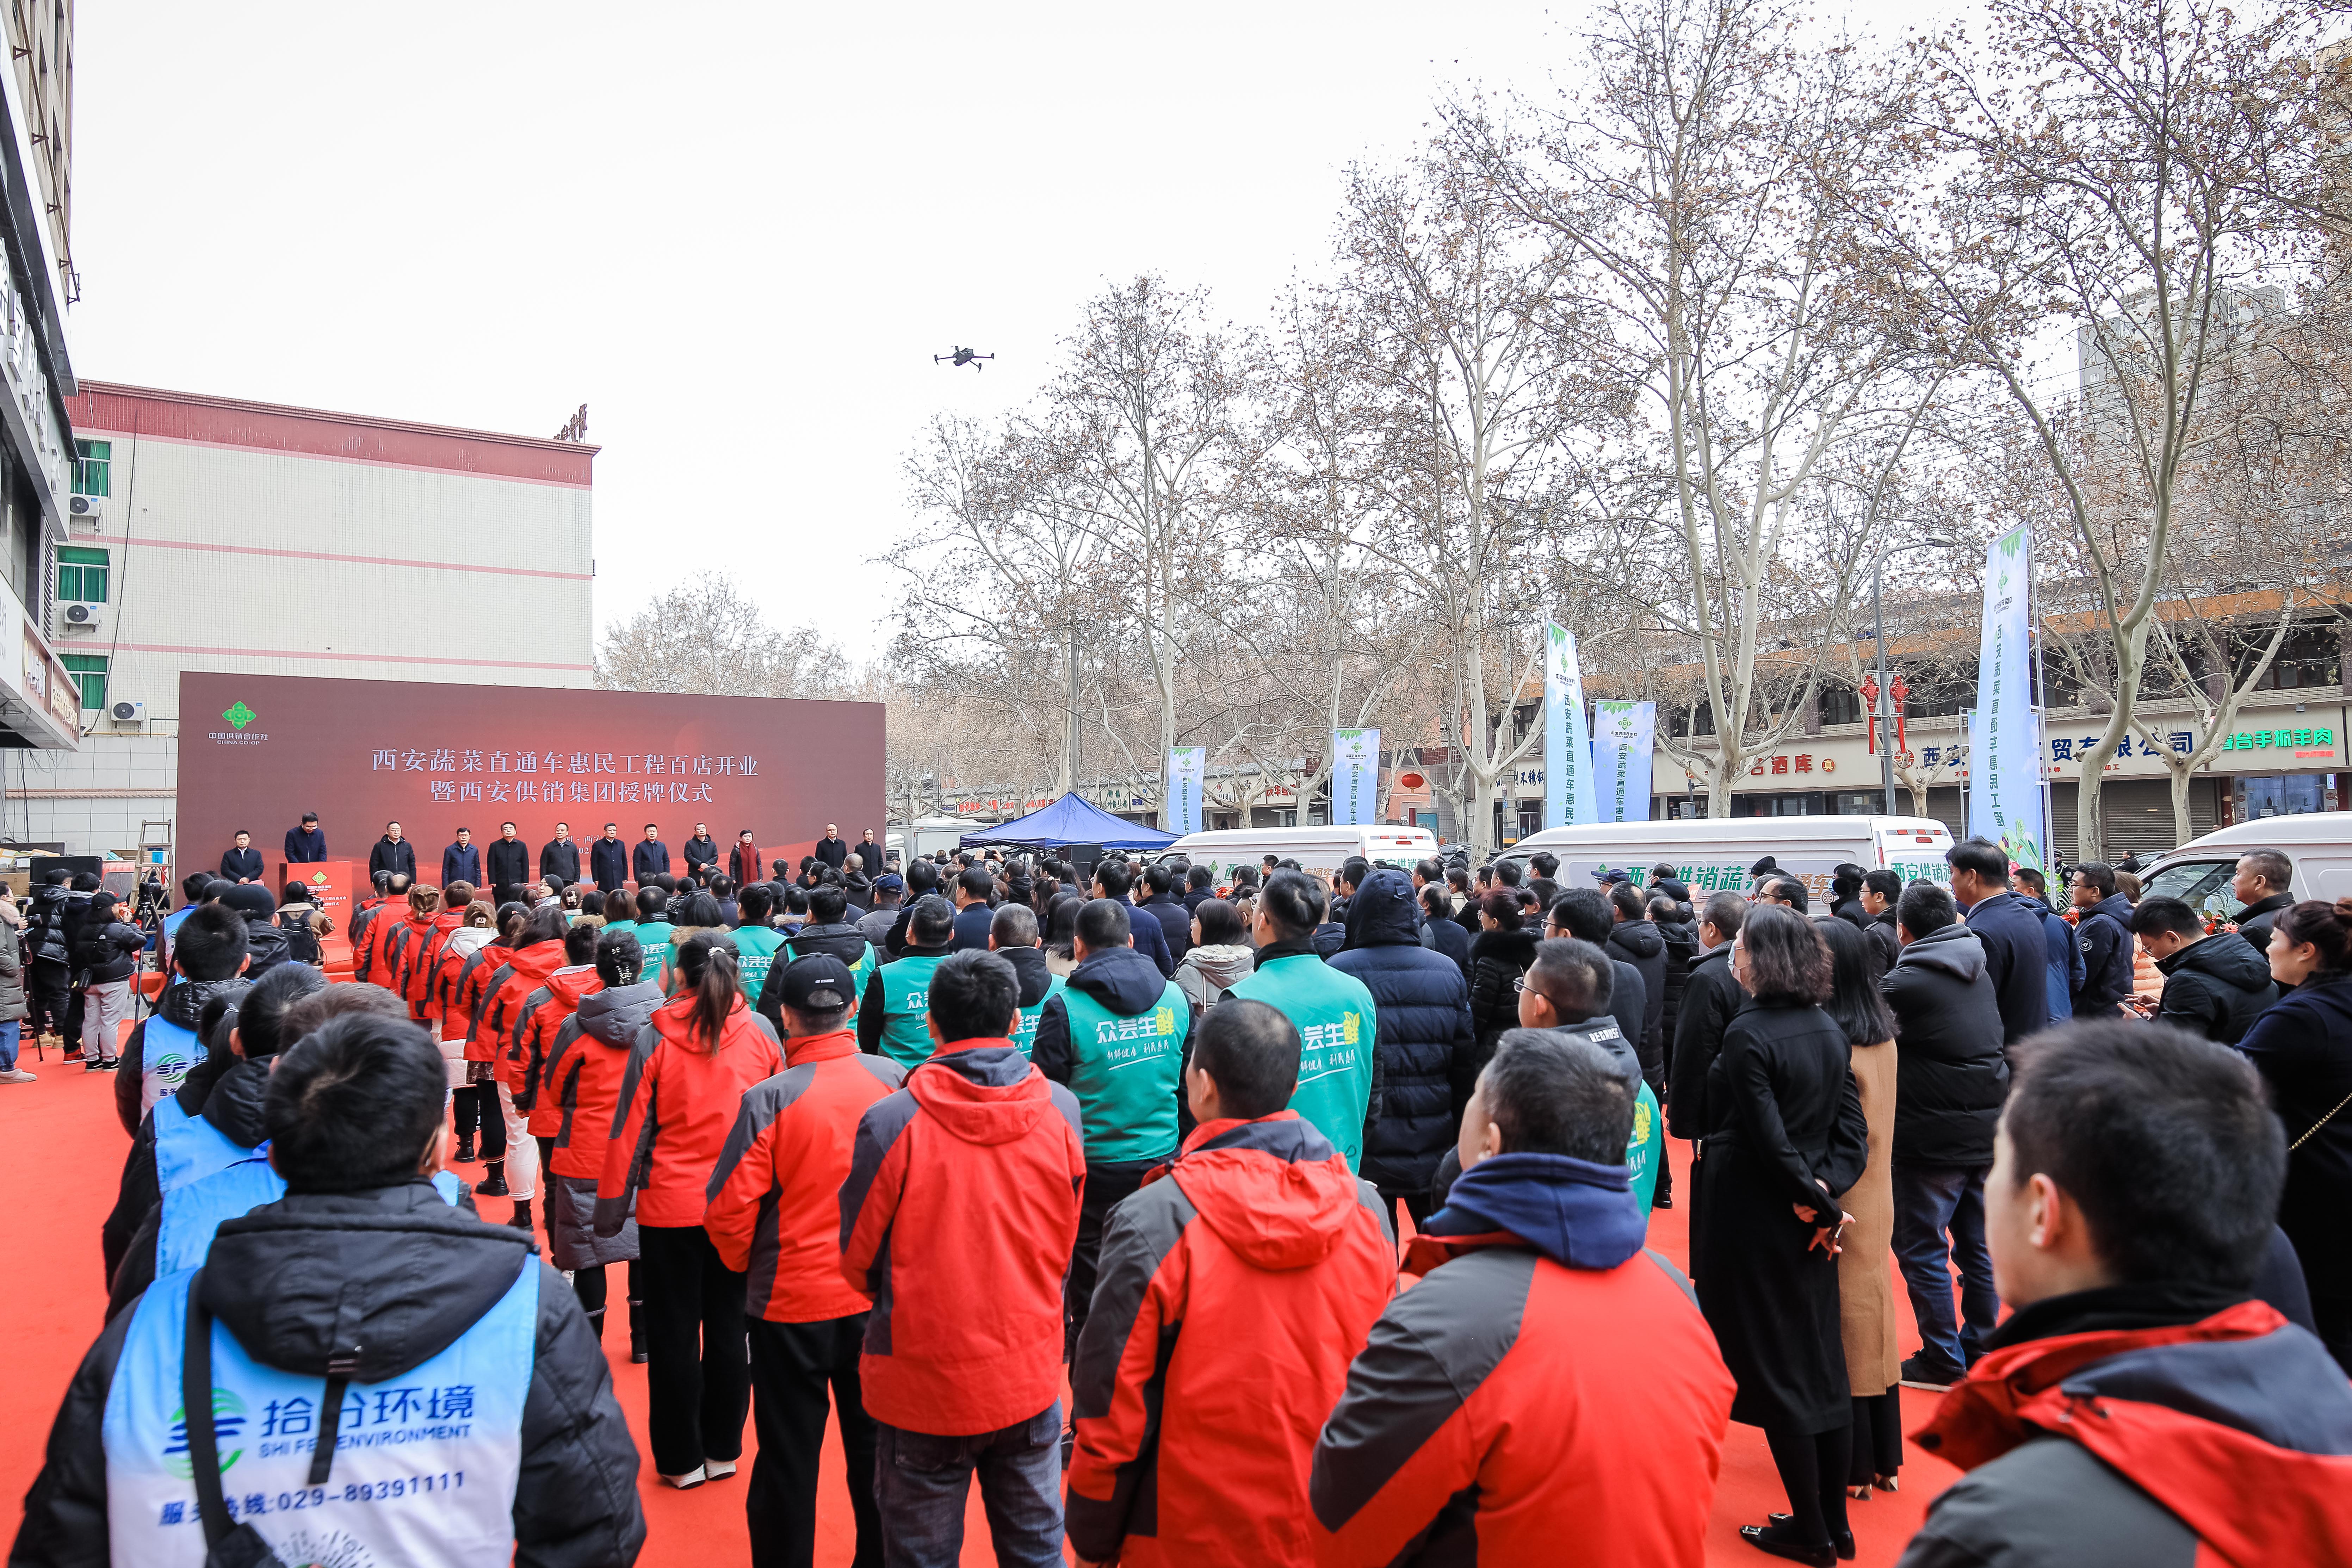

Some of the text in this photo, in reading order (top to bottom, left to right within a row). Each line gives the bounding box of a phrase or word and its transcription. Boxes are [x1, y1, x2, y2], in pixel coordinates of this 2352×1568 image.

[209, 732, 268, 740] 中国供销合作社
[372, 748, 759, 776] 西安蔬菜直通车惠民工程百店开业
[431, 780, 713, 803] 暨西安供销集团授牌仪式
[1350, 764, 1359, 825] 西安蔬菜直通车惠
[739, 952, 776, 968] 众芸生
[1299, 1011, 1361, 1051] 芸生鲜
[295, 1436, 318, 1454] FE
[336, 1424, 471, 1451] ENVIRONMENT
